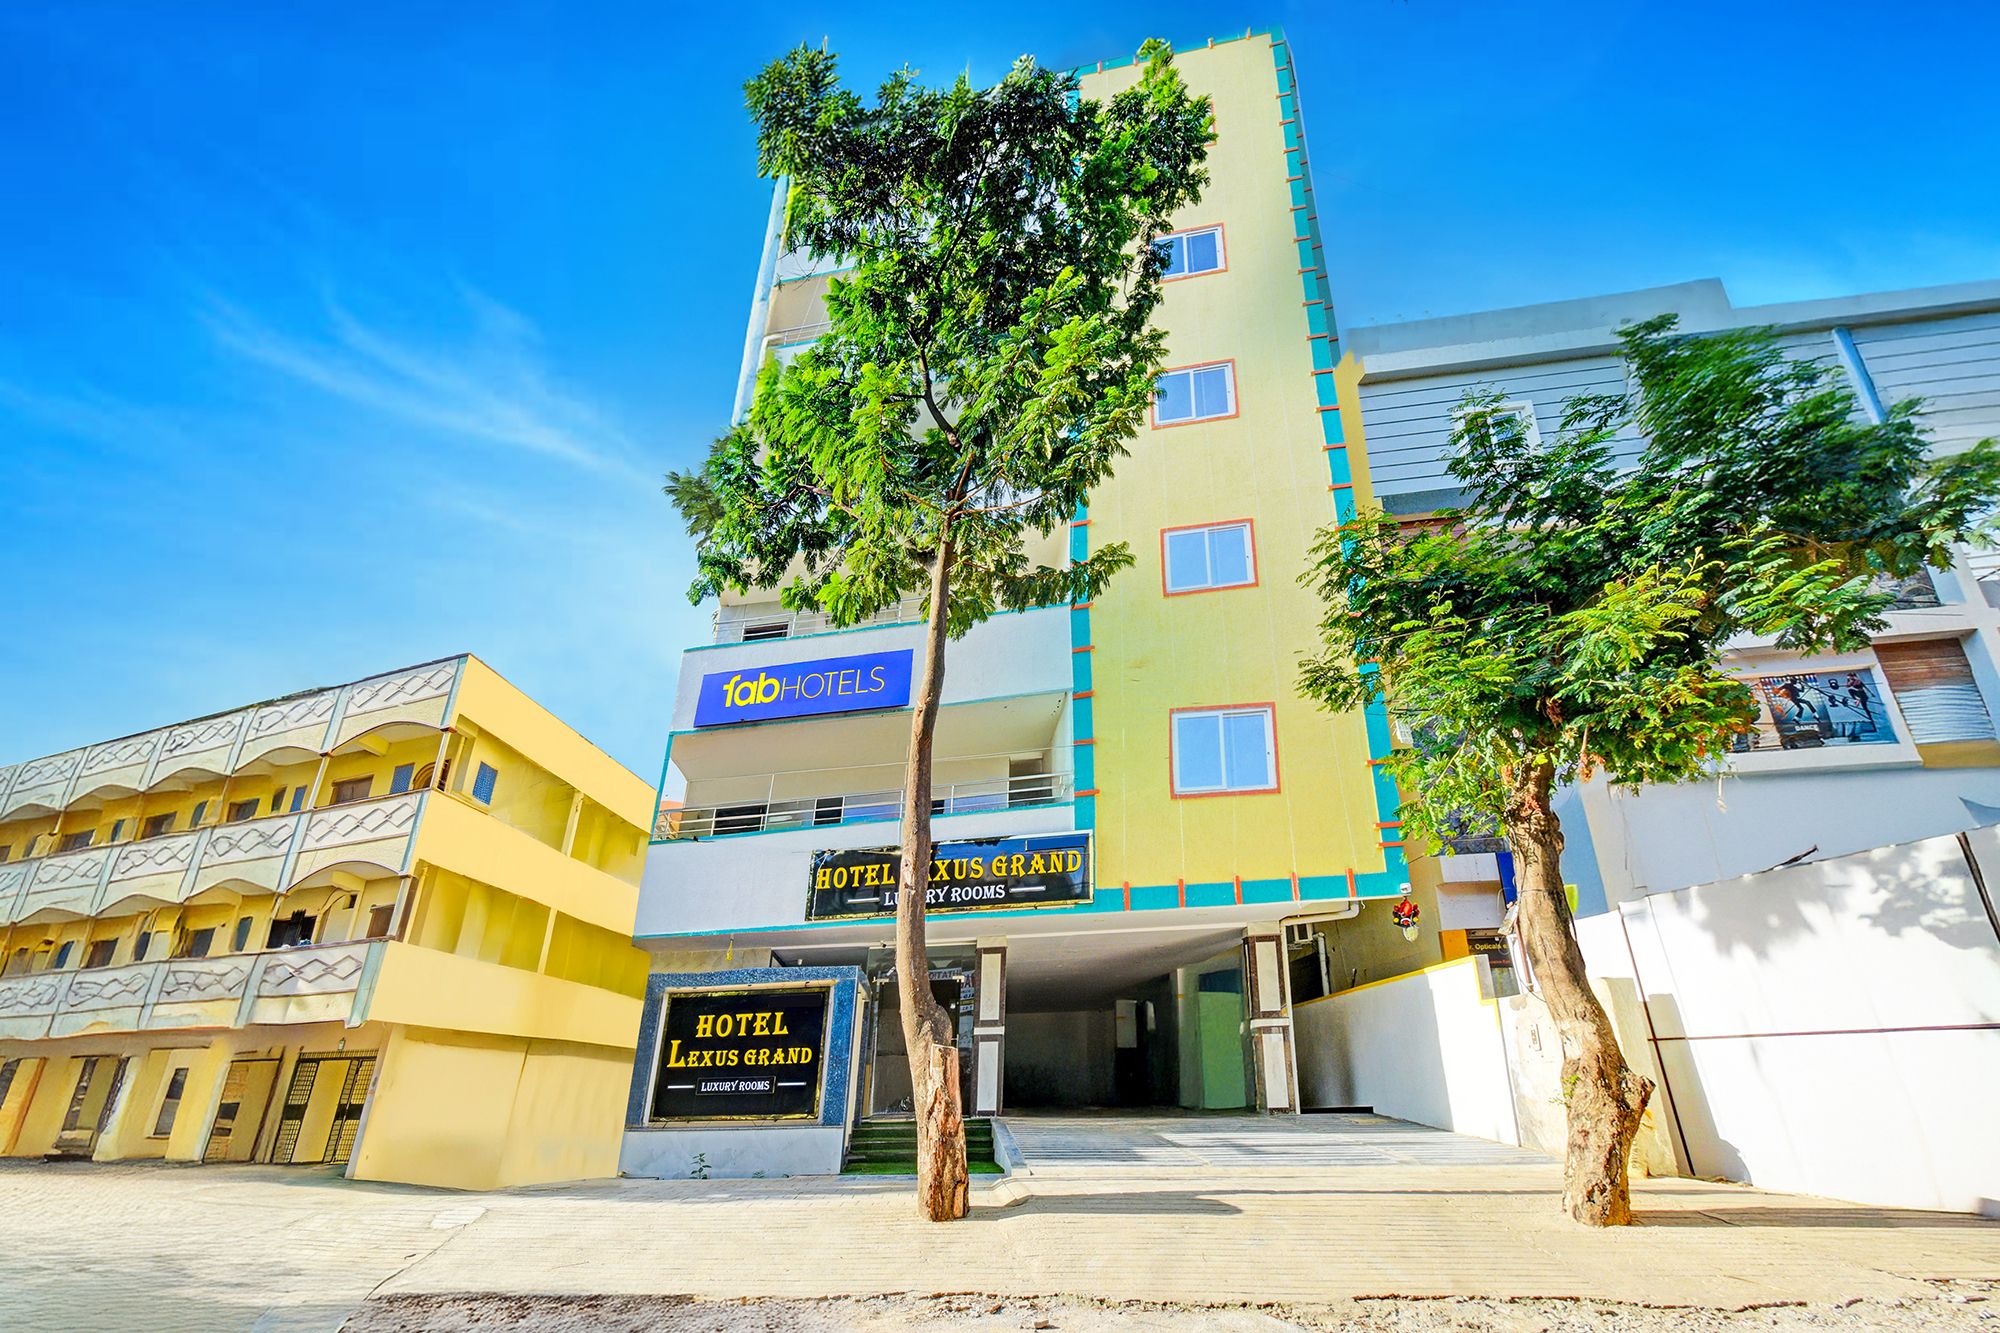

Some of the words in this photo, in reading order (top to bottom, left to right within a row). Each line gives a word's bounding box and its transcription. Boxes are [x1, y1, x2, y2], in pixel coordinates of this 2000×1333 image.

[817, 863, 895, 889] HOTEL
[928, 857, 983, 882] XUS
[991, 850, 1082, 878] GRAND
[950, 884, 1006, 902] ROOMS
[695, 1012, 789, 1038] HOTEL
[667, 1040, 739, 1068] LEXUS
[744, 1047, 813, 1067] GRAND
[700, 1080, 739, 1092] LUXURY
[738, 1080, 770, 1092] ROOMS
